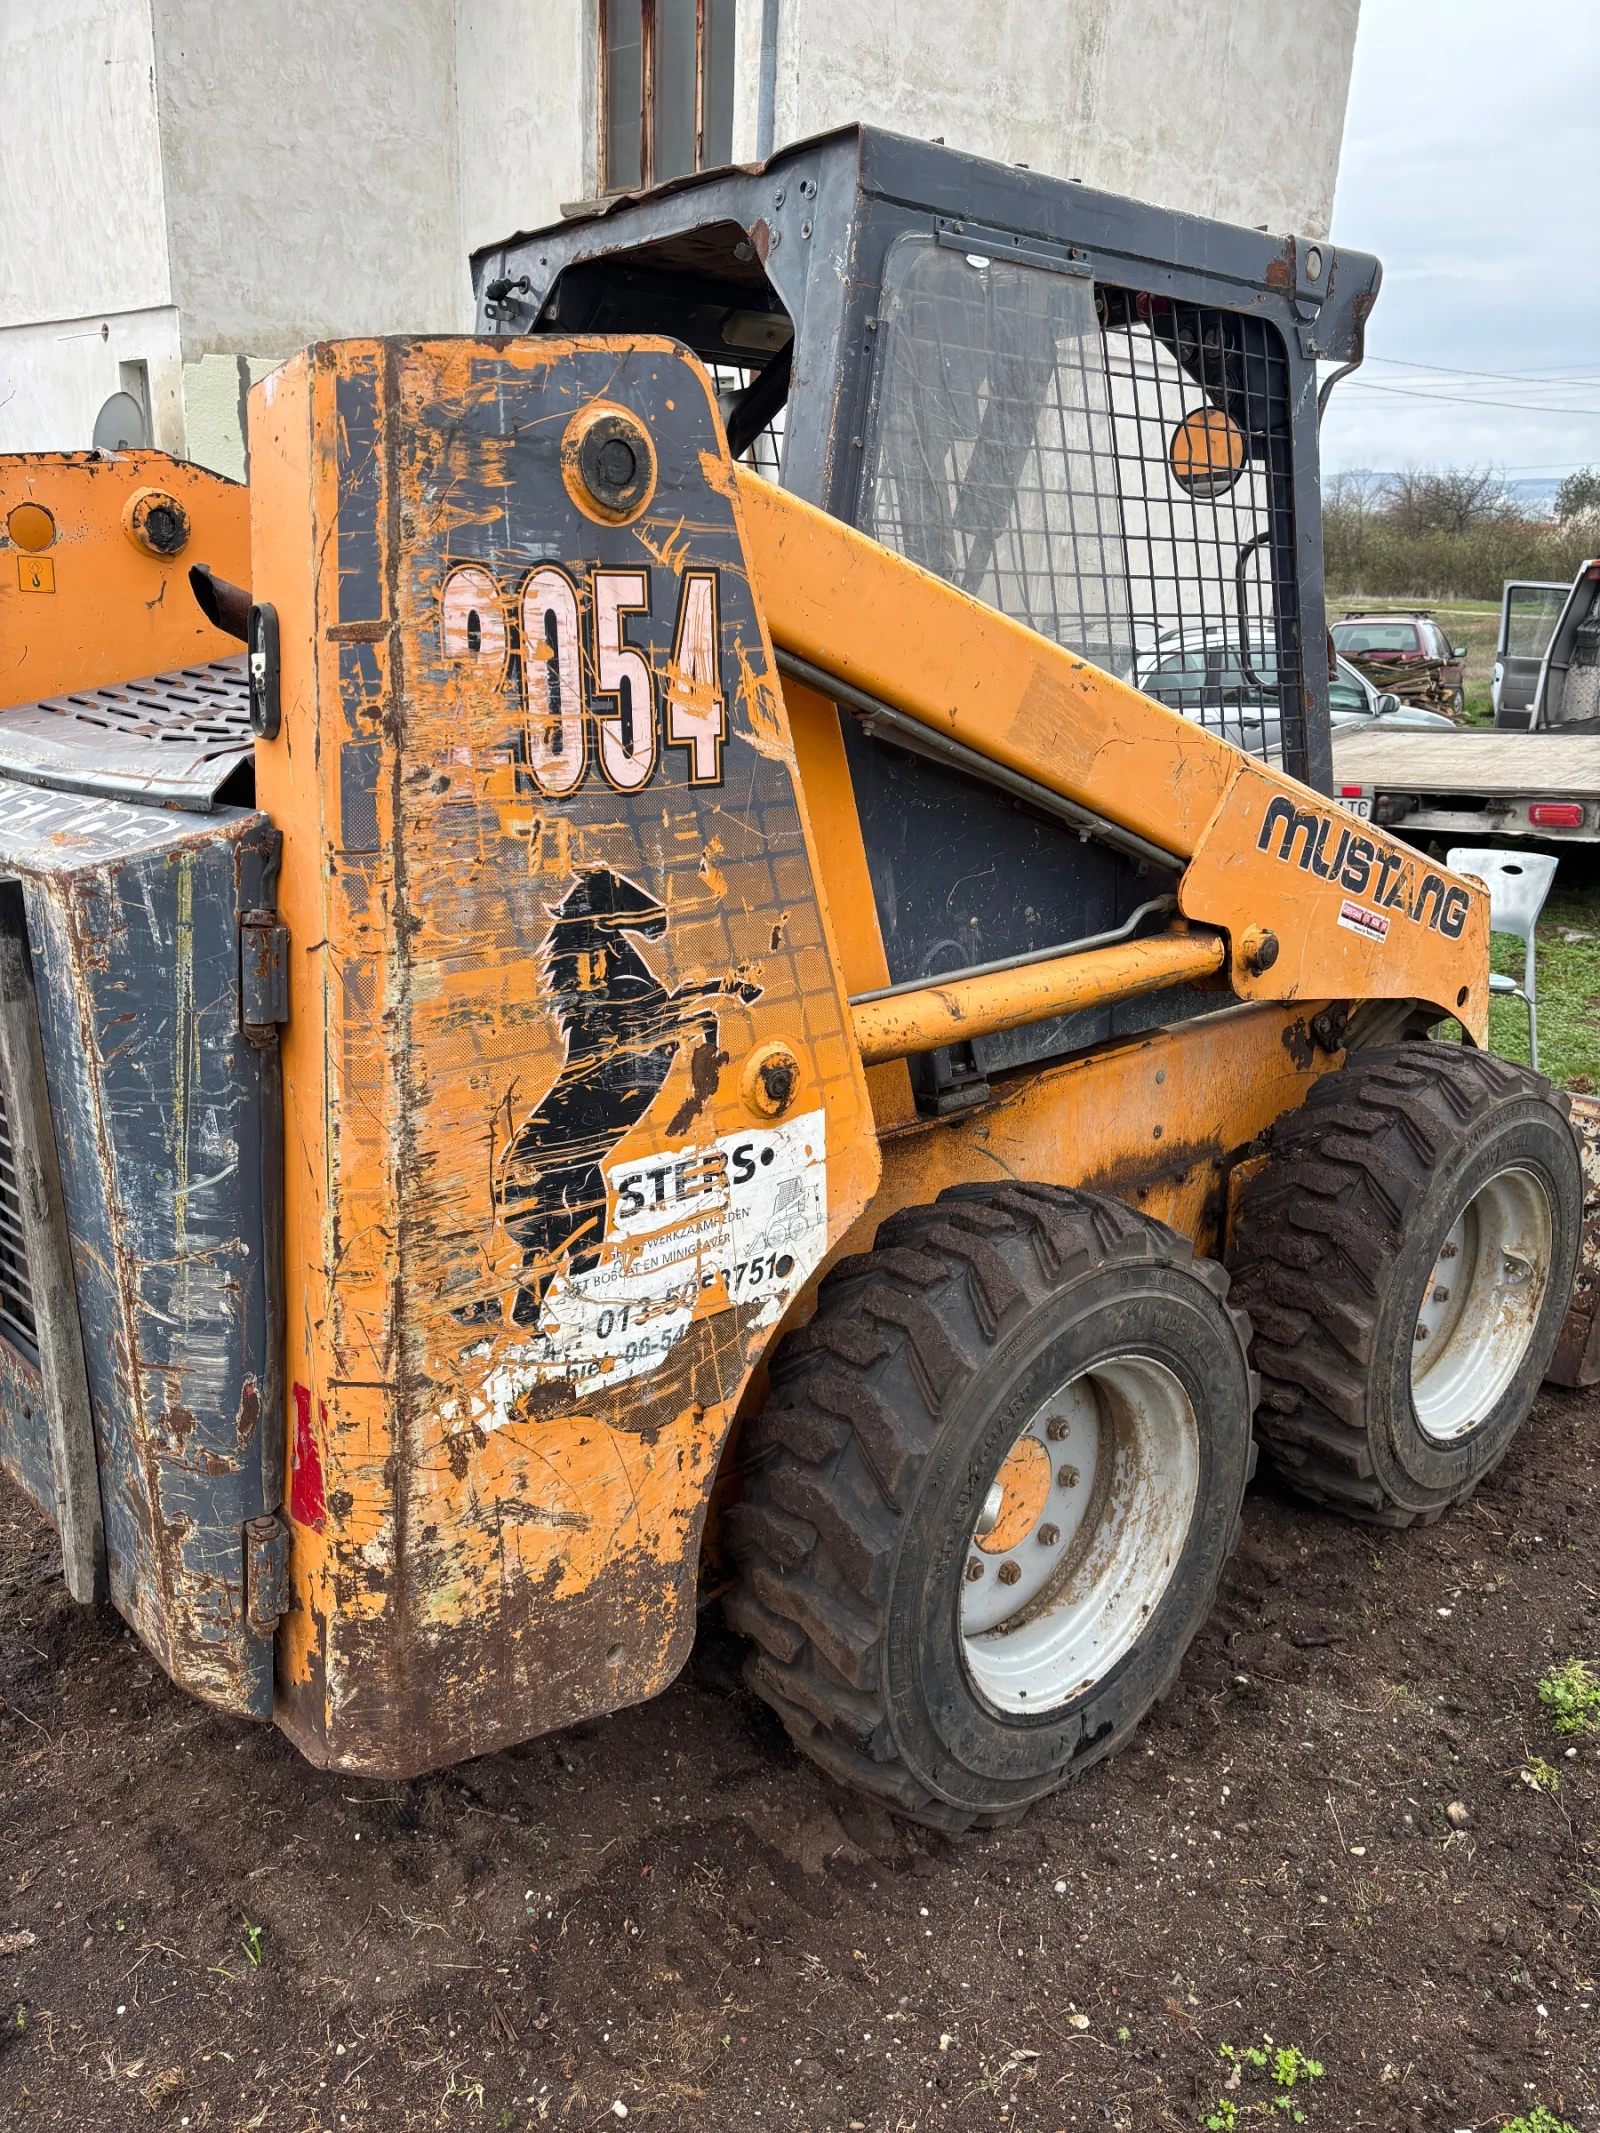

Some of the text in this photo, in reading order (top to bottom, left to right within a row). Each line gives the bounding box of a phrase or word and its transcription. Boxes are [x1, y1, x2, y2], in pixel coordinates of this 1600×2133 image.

[434, 560, 729, 799] 2054
[1256, 796, 1470, 941] MUSTANG
[641, 1256, 660, 1271] EN
[662, 1233, 731, 1264] MINIGAVER
[938, 1442, 955, 1474] NYLON
